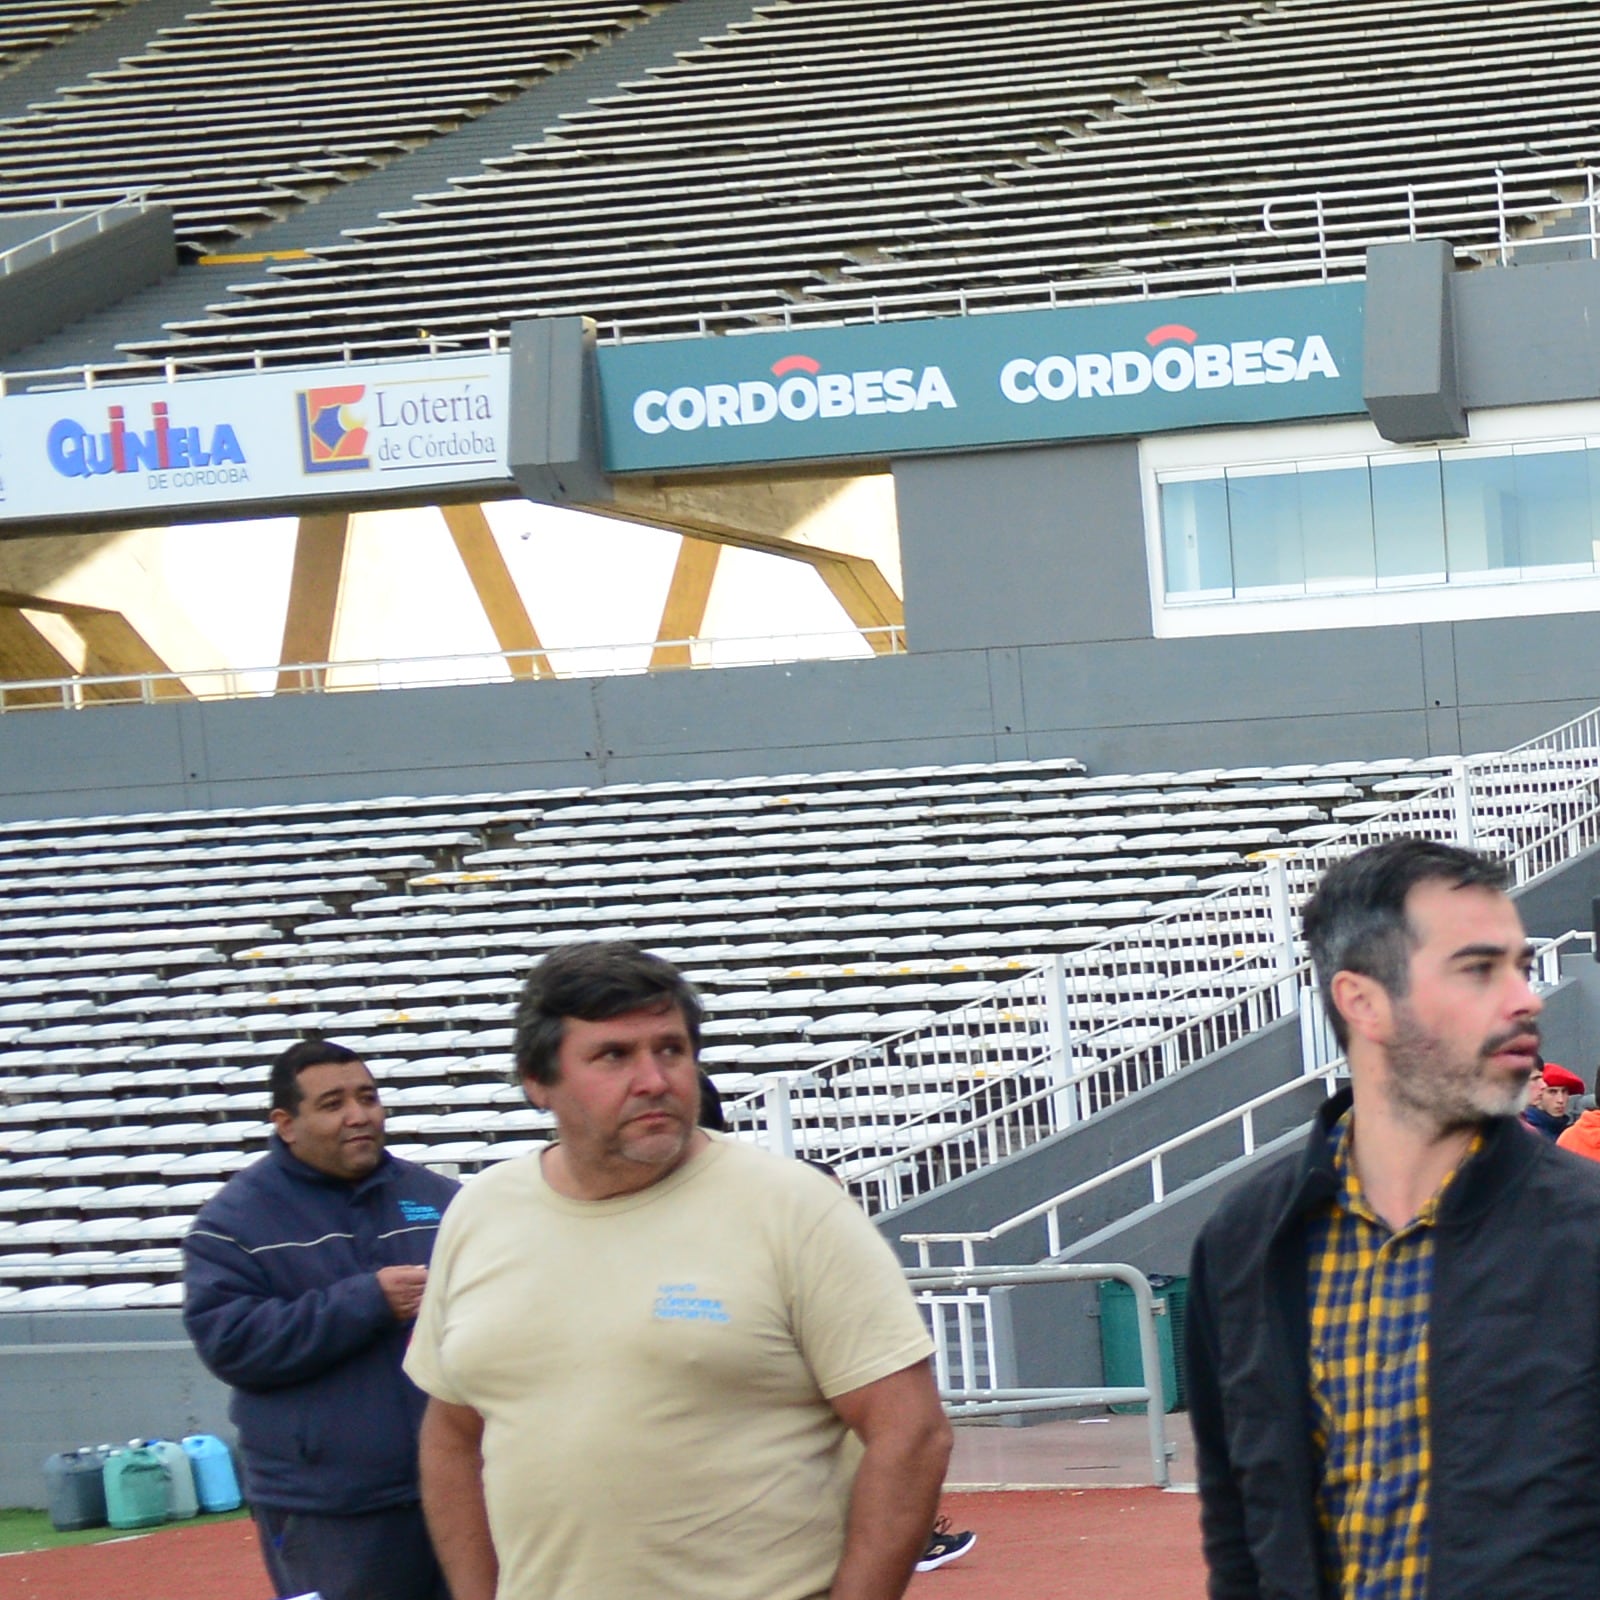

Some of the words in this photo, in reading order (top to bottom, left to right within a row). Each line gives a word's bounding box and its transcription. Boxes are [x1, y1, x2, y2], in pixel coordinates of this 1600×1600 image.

[1000, 335, 1340, 404] CORDOBESA
[376, 384, 493, 428] Lotería
[633, 366, 957, 434] CORDOBESA
[378, 438, 401, 461] de
[408, 432, 496, 459] Córdoba
[148, 474, 168, 490] DE
[172, 470, 249, 488] CORDOBA
